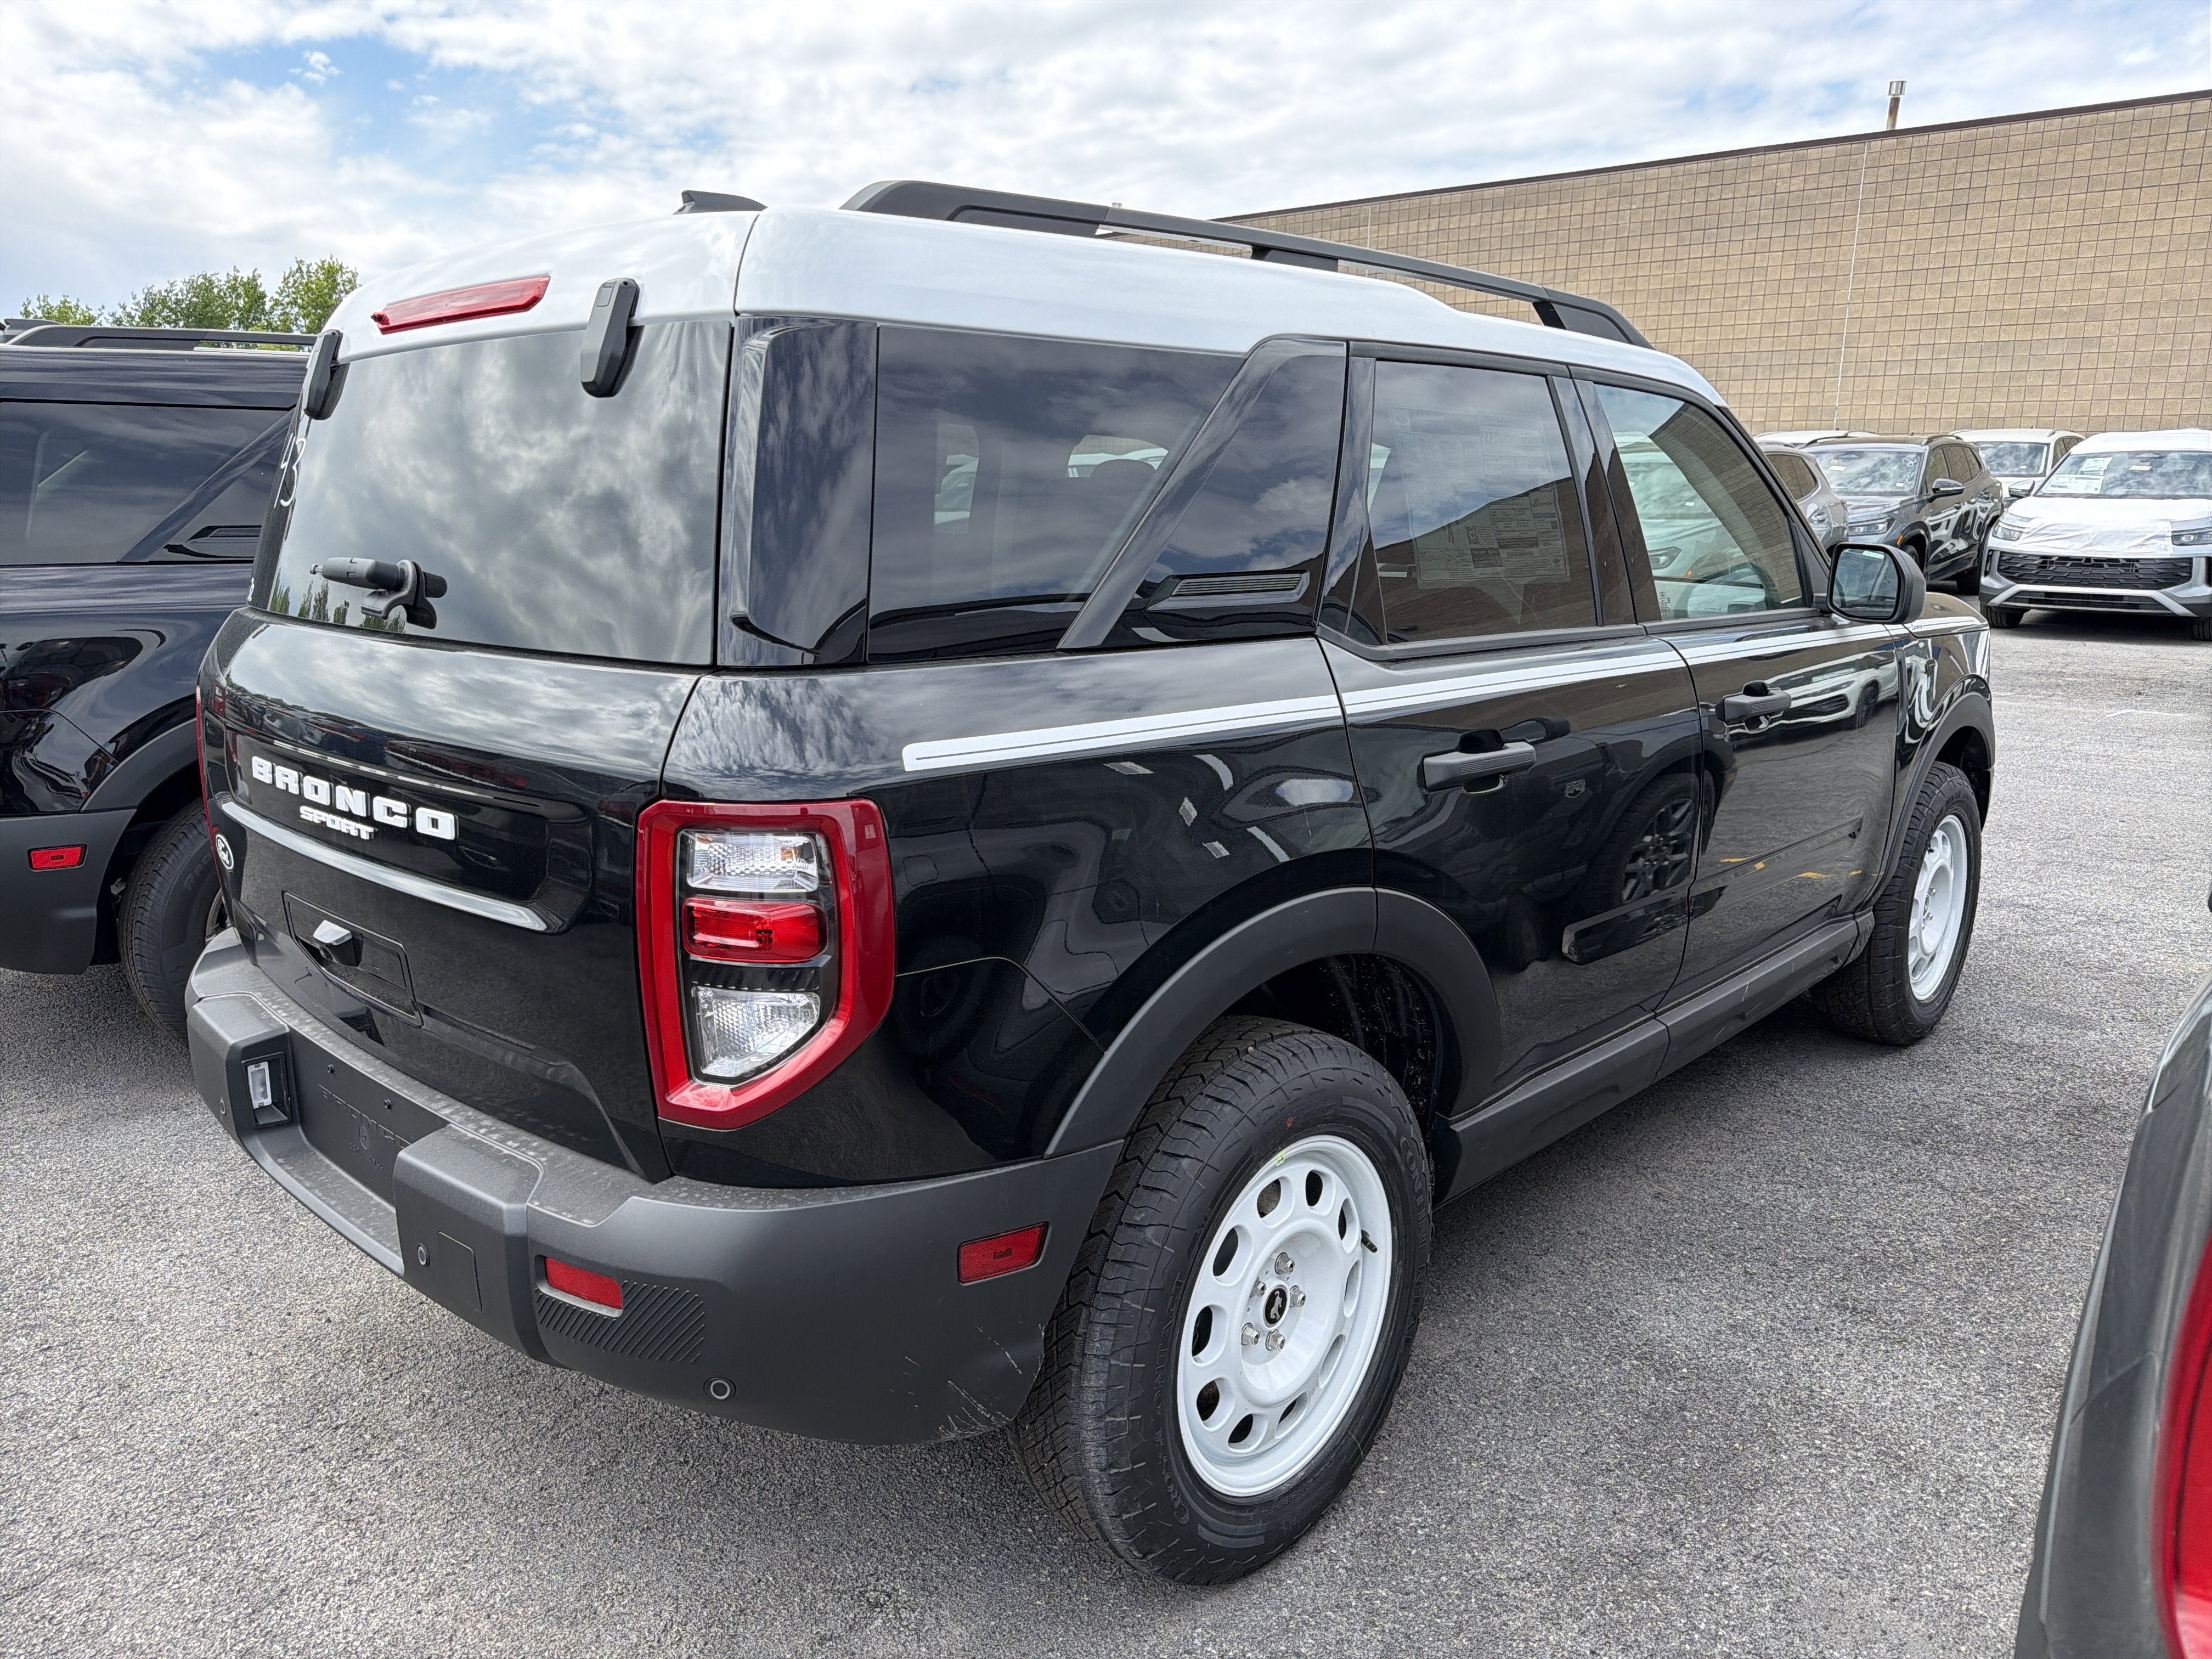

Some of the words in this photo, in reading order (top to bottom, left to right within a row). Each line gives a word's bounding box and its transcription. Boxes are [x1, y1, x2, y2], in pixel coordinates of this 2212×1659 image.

[252, 755, 458, 840] BRONCO
[300, 805, 376, 840] SPORT
[1399, 1135, 1427, 1355] CONTINENTAL
